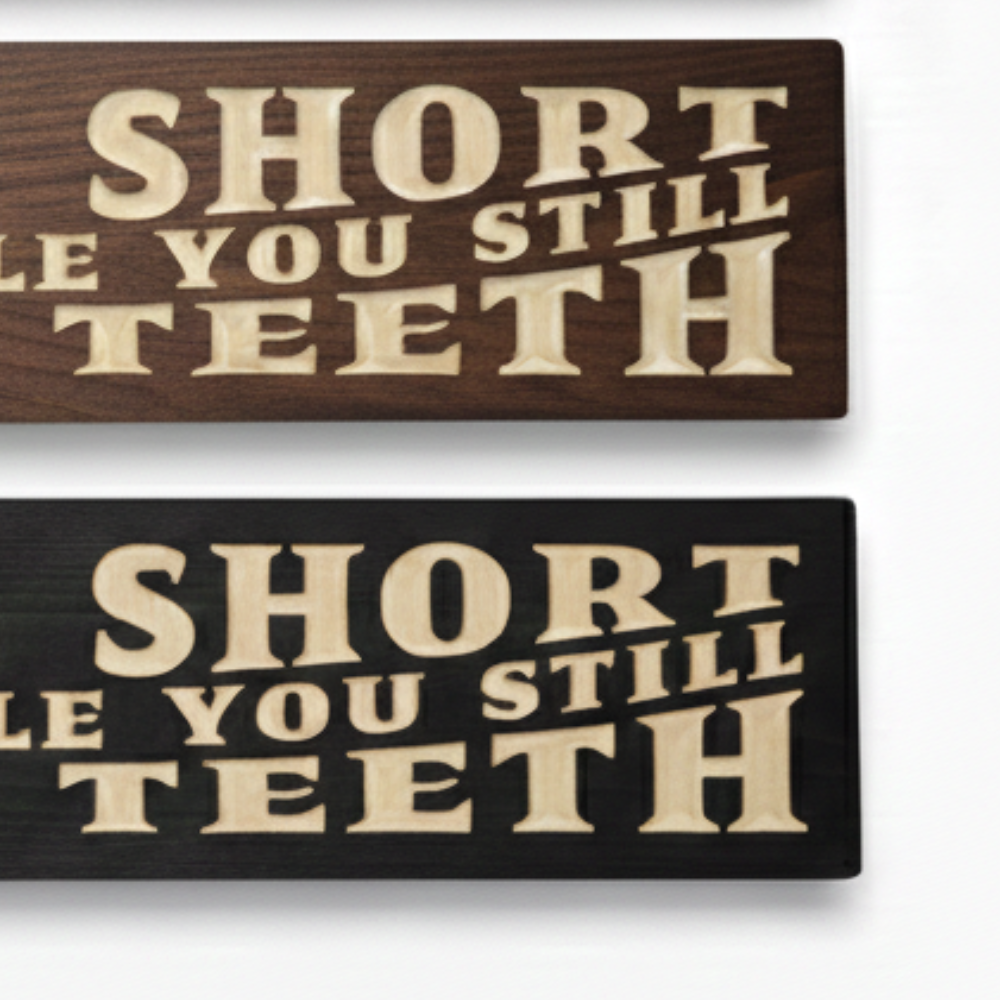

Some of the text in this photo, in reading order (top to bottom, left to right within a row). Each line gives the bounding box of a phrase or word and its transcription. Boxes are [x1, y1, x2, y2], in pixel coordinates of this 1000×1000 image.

[86, 85, 788, 222] SHORT
[154, 214, 412, 289] YOU
[472, 165, 788, 263] STILL
[53, 232, 793, 377] TEETH
[92, 542, 799, 678] SHORT
[162, 673, 424, 746] YOU
[481, 621, 803, 720] STILL
[59, 691, 807, 834] TEETH
